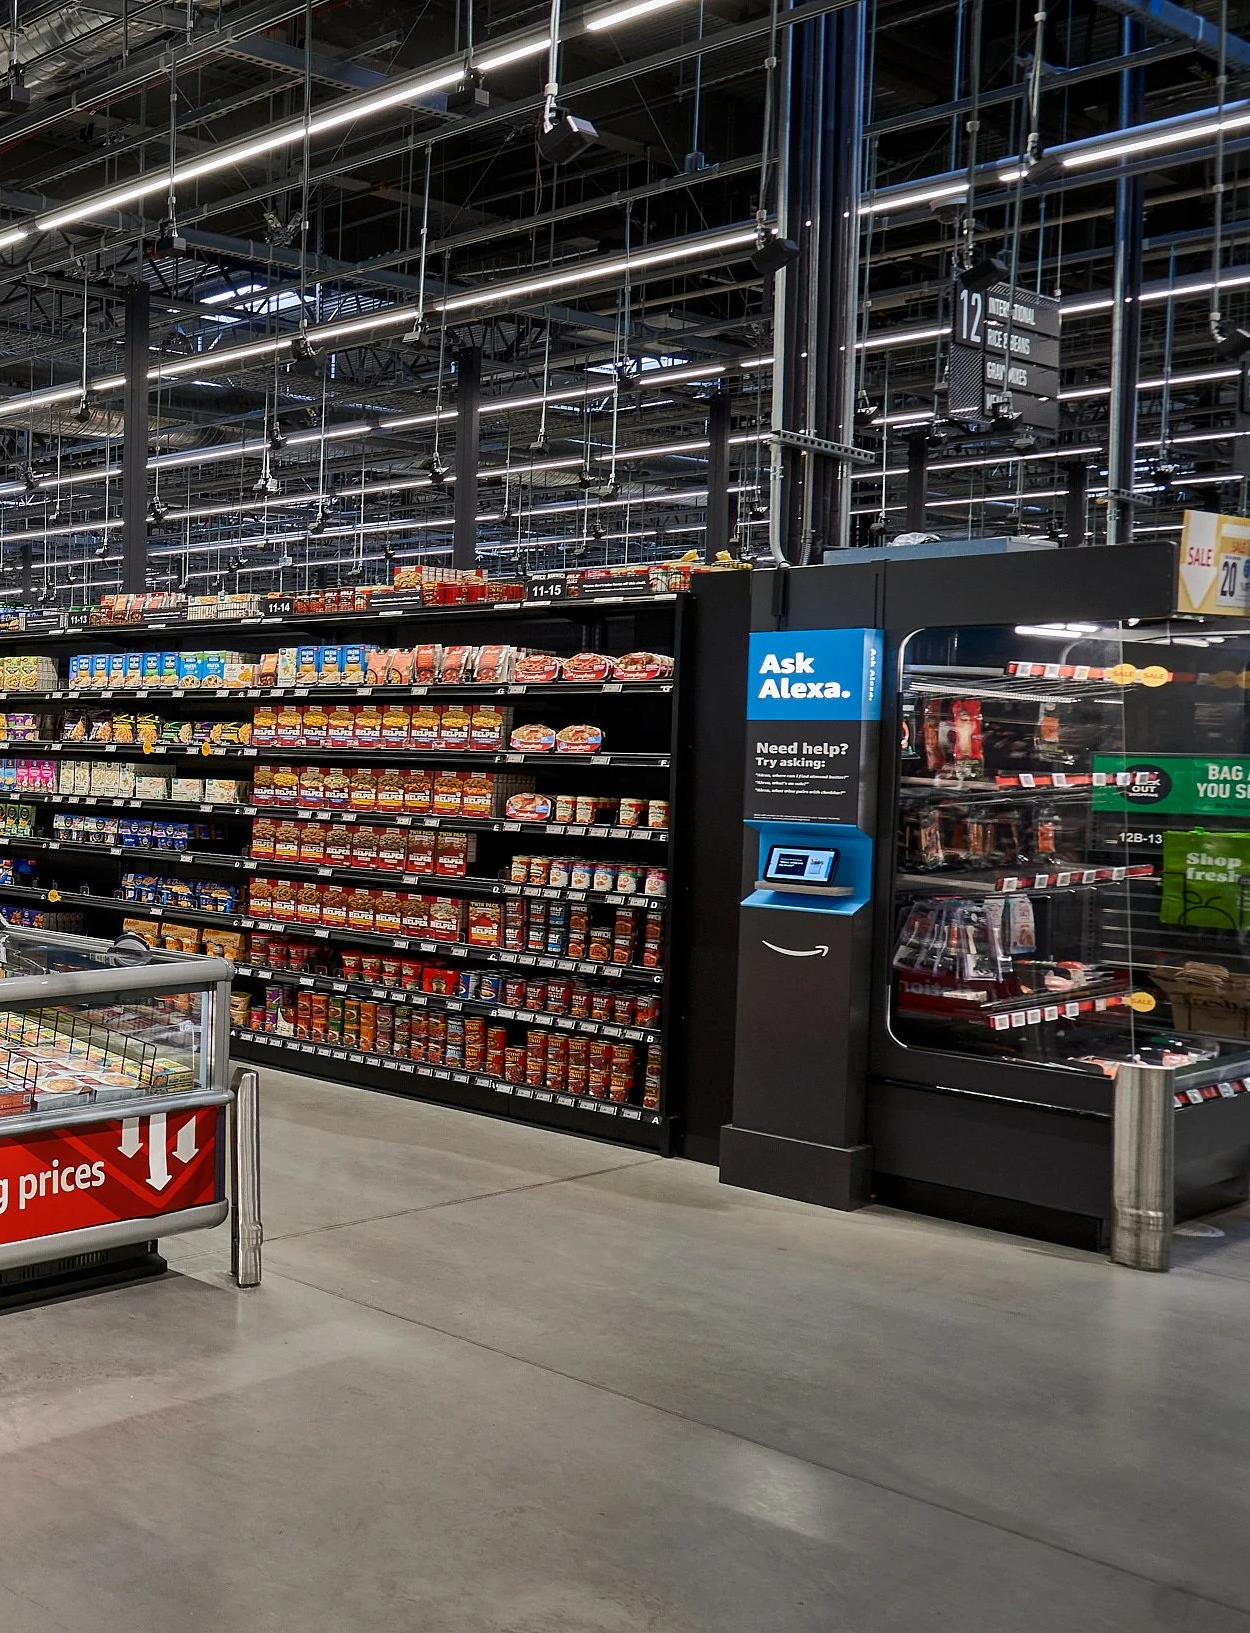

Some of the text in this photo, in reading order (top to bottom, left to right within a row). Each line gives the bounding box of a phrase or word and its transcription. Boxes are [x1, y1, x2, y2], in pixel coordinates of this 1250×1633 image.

[960, 289, 982, 343] 12
[988, 297, 1036, 325] INTERTIONAL
[987, 328, 1003, 348] RICE
[1009, 334, 1030, 355] BEANS
[1187, 545, 1213, 568] SALE
[1220, 560, 1238, 598] 20
[531, 584, 562, 597] 11-15
[268, 602, 291, 613] 11-14
[70, 615, 88, 624] 11-13
[759, 652, 815, 674] Ask
[1142, 671, 1165, 681] SALE
[758, 677, 851, 699] Alexa.
[756, 742, 849, 758] Need help?
[755, 757, 826, 770] Try asking:
[1207, 765, 1244, 782] BAG
[1131, 785, 1157, 793] OUT
[1196, 783, 1231, 799] YOU
[1118, 832, 1163, 845] 12B-13
[1185, 853, 1242, 869] Shop
[1185, 868, 1242, 883] fresh
[650, 901, 658, 909] D
[646, 1035, 654, 1043] B
[651, 1116, 660, 1125] A
[17, 1158, 107, 1209] prices
